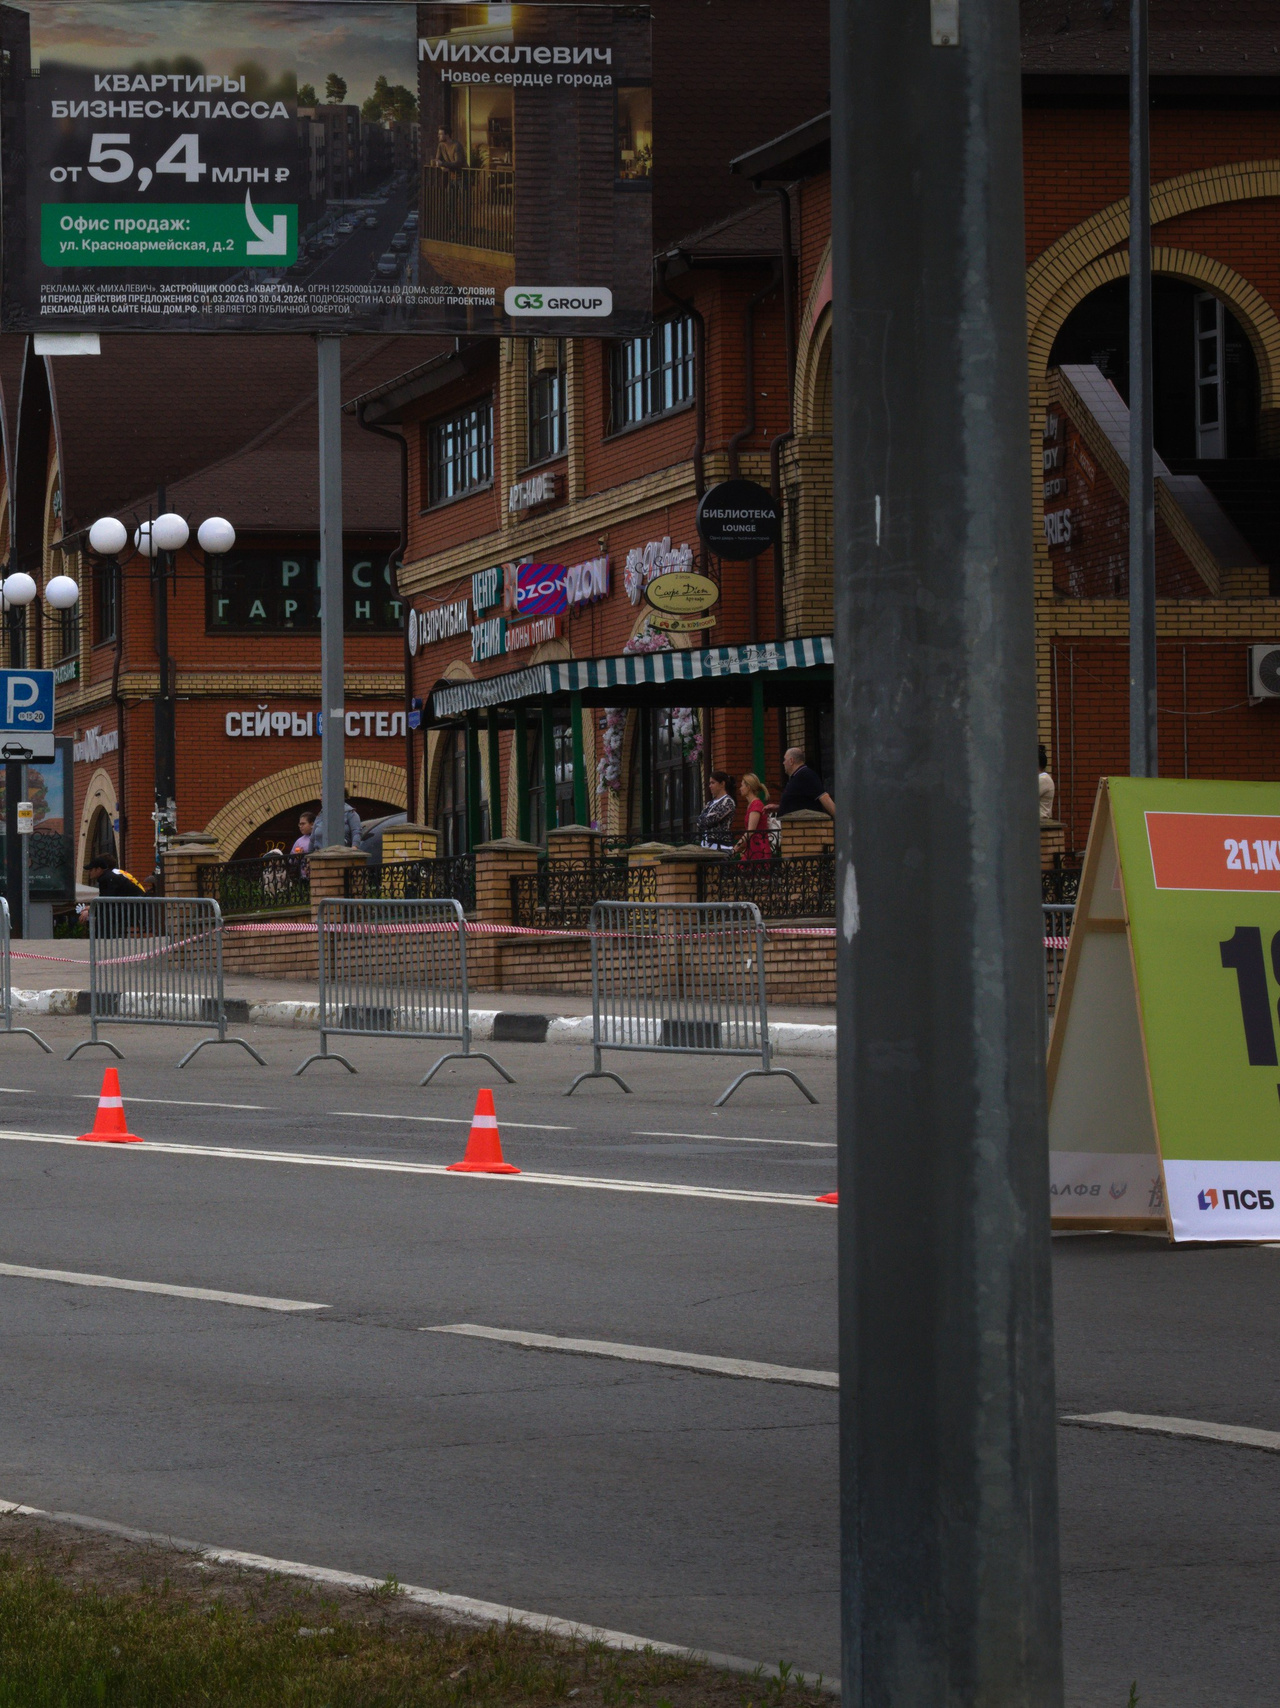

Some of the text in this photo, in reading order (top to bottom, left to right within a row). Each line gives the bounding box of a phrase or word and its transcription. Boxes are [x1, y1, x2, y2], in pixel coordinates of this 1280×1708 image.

[418, 39, 612, 65] Михалевич
[94, 74, 246, 93] КВАРТИРЫ
[441, 69, 612, 87] Новое сердце города
[51, 100, 289, 119] БИЗНЕС-КЛАССА
[87, 133, 207, 192] 5,4
[212, 167, 269, 183] МЛН
[60, 215, 190, 235] Офис продаж:
[59, 239, 235, 253] ул. Красноармейская, д.2
[41, 284, 80, 293] РЕКЛАМА
[82, 284, 95, 293] ЖК
[160, 282, 217, 294] ЗАСТРОЙЩИК
[219, 285, 235, 294] ООО
[250, 285, 293, 294] «КВАРТАЛ
[308, 285, 329, 294] ОГРН
[393, 286, 401, 294] ID
[402, 286, 429, 296] ДОМА:
[457, 286, 495, 295] УСЛОВИЯ
[41, 295, 46, 303] И
[48, 295, 82, 304] ПЕРИОД
[83, 294, 127, 304] ДЕЙСТВИЯ
[129, 295, 192, 304] ПРЕДЛОЖЕНИЯ
[193, 295, 199, 303] С
[201, 295, 244, 304] 01.03.2026
[246, 295, 257, 304] ПО
[309, 295, 370, 305] ПОДРОБНОСТИ
[372, 296, 383, 304] НА
[447, 296, 495, 306] ПРОЕКТНАЯ
[41, 305, 96, 315] ДЕКЛАРАЦИЯ
[98, 305, 110, 314] НА
[112, 304, 139, 314] САЙТЕ
[202, 305, 212, 314] НЕ
[215, 305, 256, 314] ЯВЛЯЕТСЯ
[259, 304, 309, 314] ПУБЛИЧНОЙ
[312, 304, 352, 314] ОФЕРТОЙ.
[514, 293, 602, 309] G3 GROUP
[508, 472, 555, 513] АРТ-КАФЕ
[703, 509, 776, 519] БИБЛИОТЕКА
[723, 524, 756, 532] LOUNGE
[282, 561, 404, 588] РС
[567, 557, 607, 606] OZON
[472, 568, 500, 612] ЦЕНТР
[654, 585, 679, 600] Carpe
[419, 599, 468, 645] ГАЗПРОМБАНК
[531, 616, 556, 646] ОПТИКИ
[470, 617, 501, 663] ЗРЕНИЯ
[34, 712, 44, 721] 20
[225, 704, 313, 737] СЕЙФЫ
[345, 712, 407, 737] СТЕЛ
[1224, 838, 1280, 874] 21,1К
[1219, 925, 1280, 1066] 1
[1223, 1189, 1274, 1210] ПСБ
